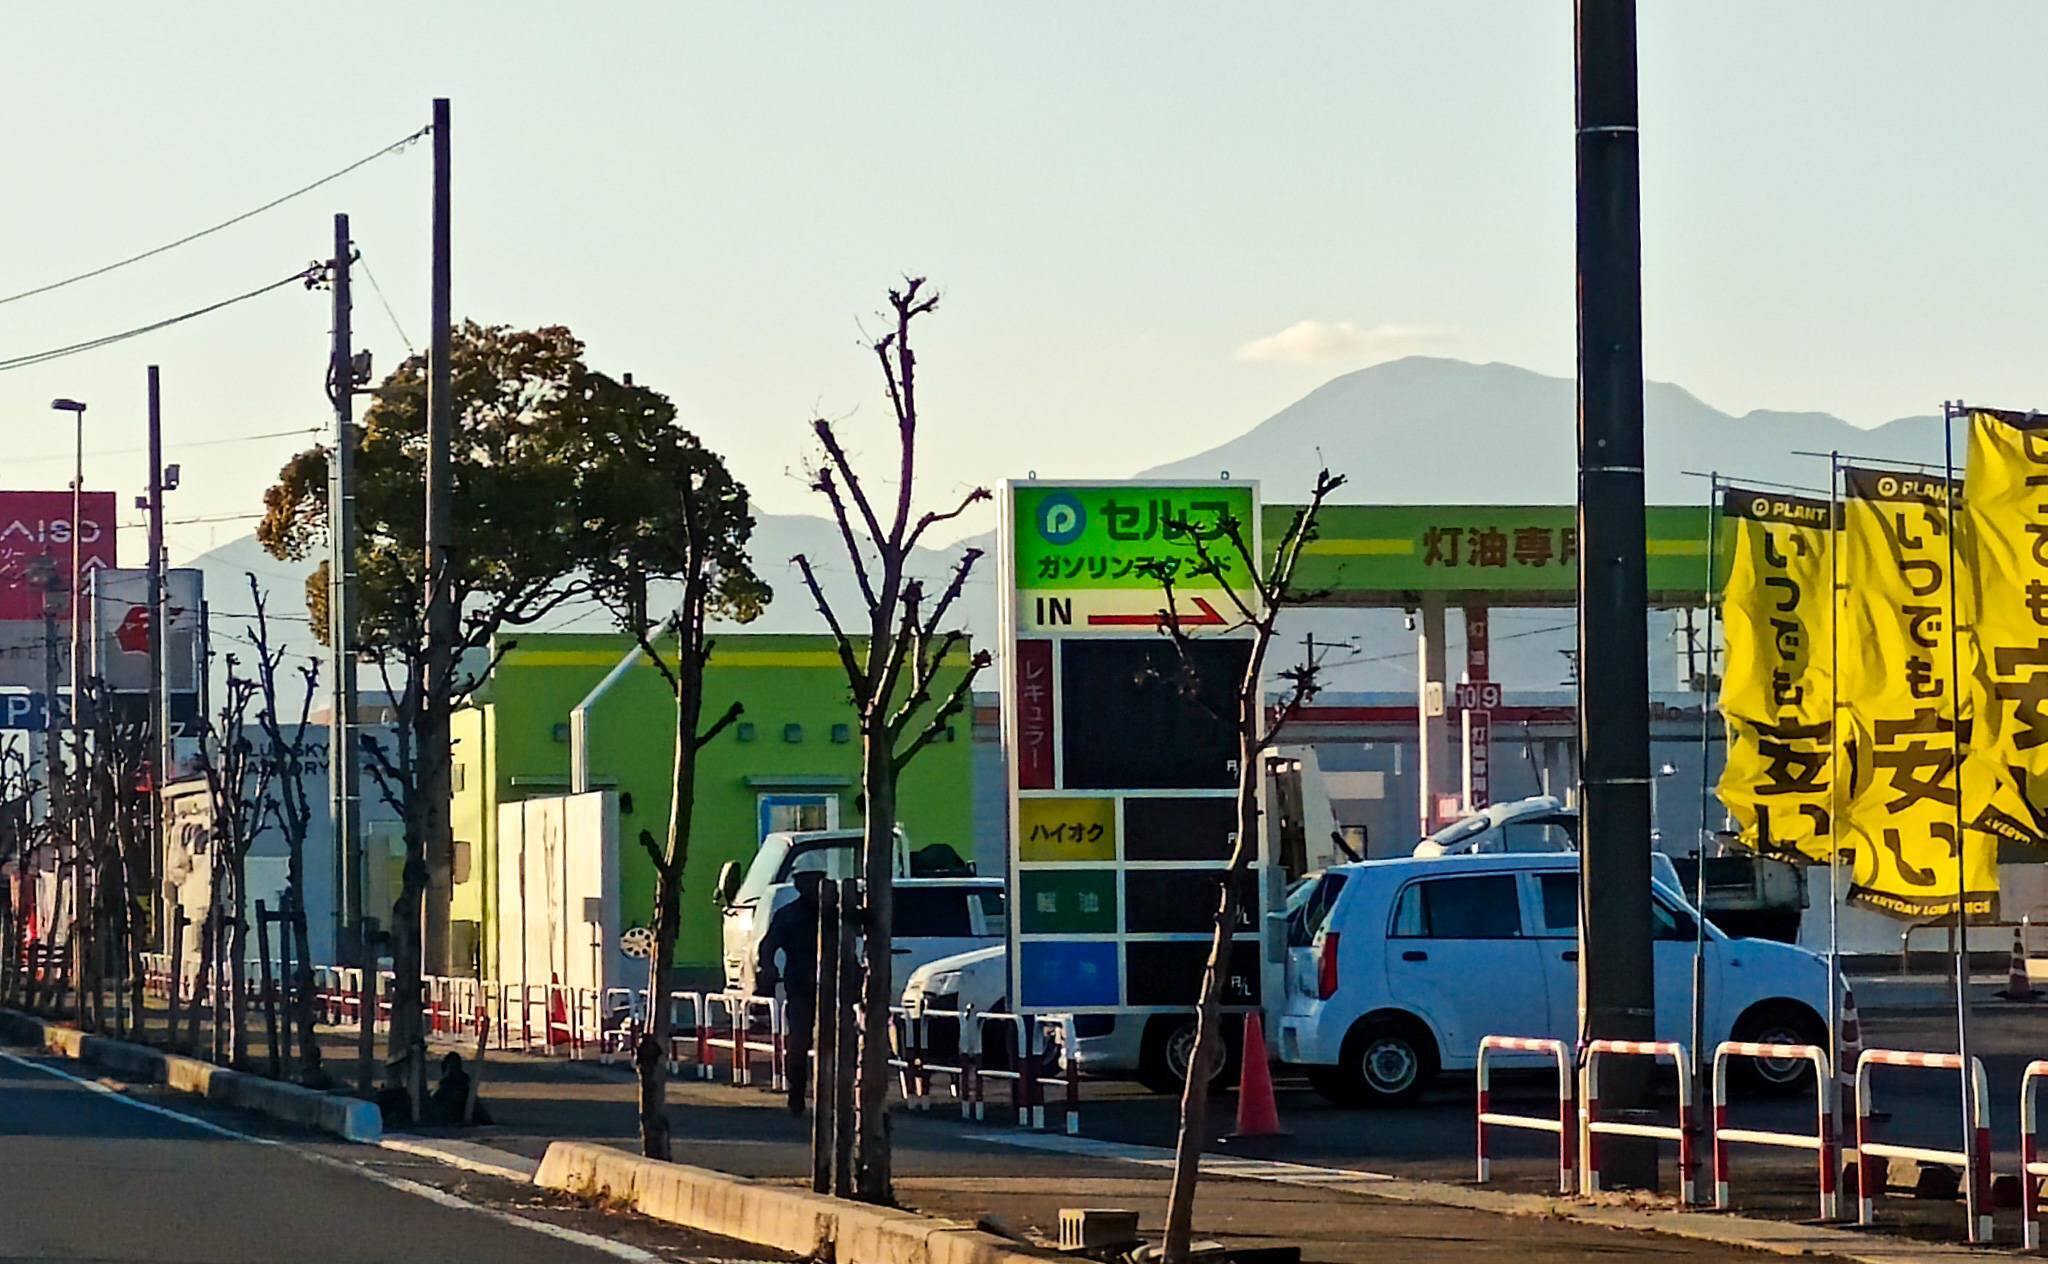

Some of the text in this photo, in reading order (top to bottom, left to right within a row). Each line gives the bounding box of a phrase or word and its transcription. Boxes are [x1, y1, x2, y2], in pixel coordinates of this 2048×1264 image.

[1100, 498, 1230, 541] セルフ
[1773, 502, 1827, 521] PLANT
[1037, 555, 1232, 580] ガソリンスタンド
[1036, 597, 1072, 625] IN
[1029, 823, 1104, 843] ハイオク
